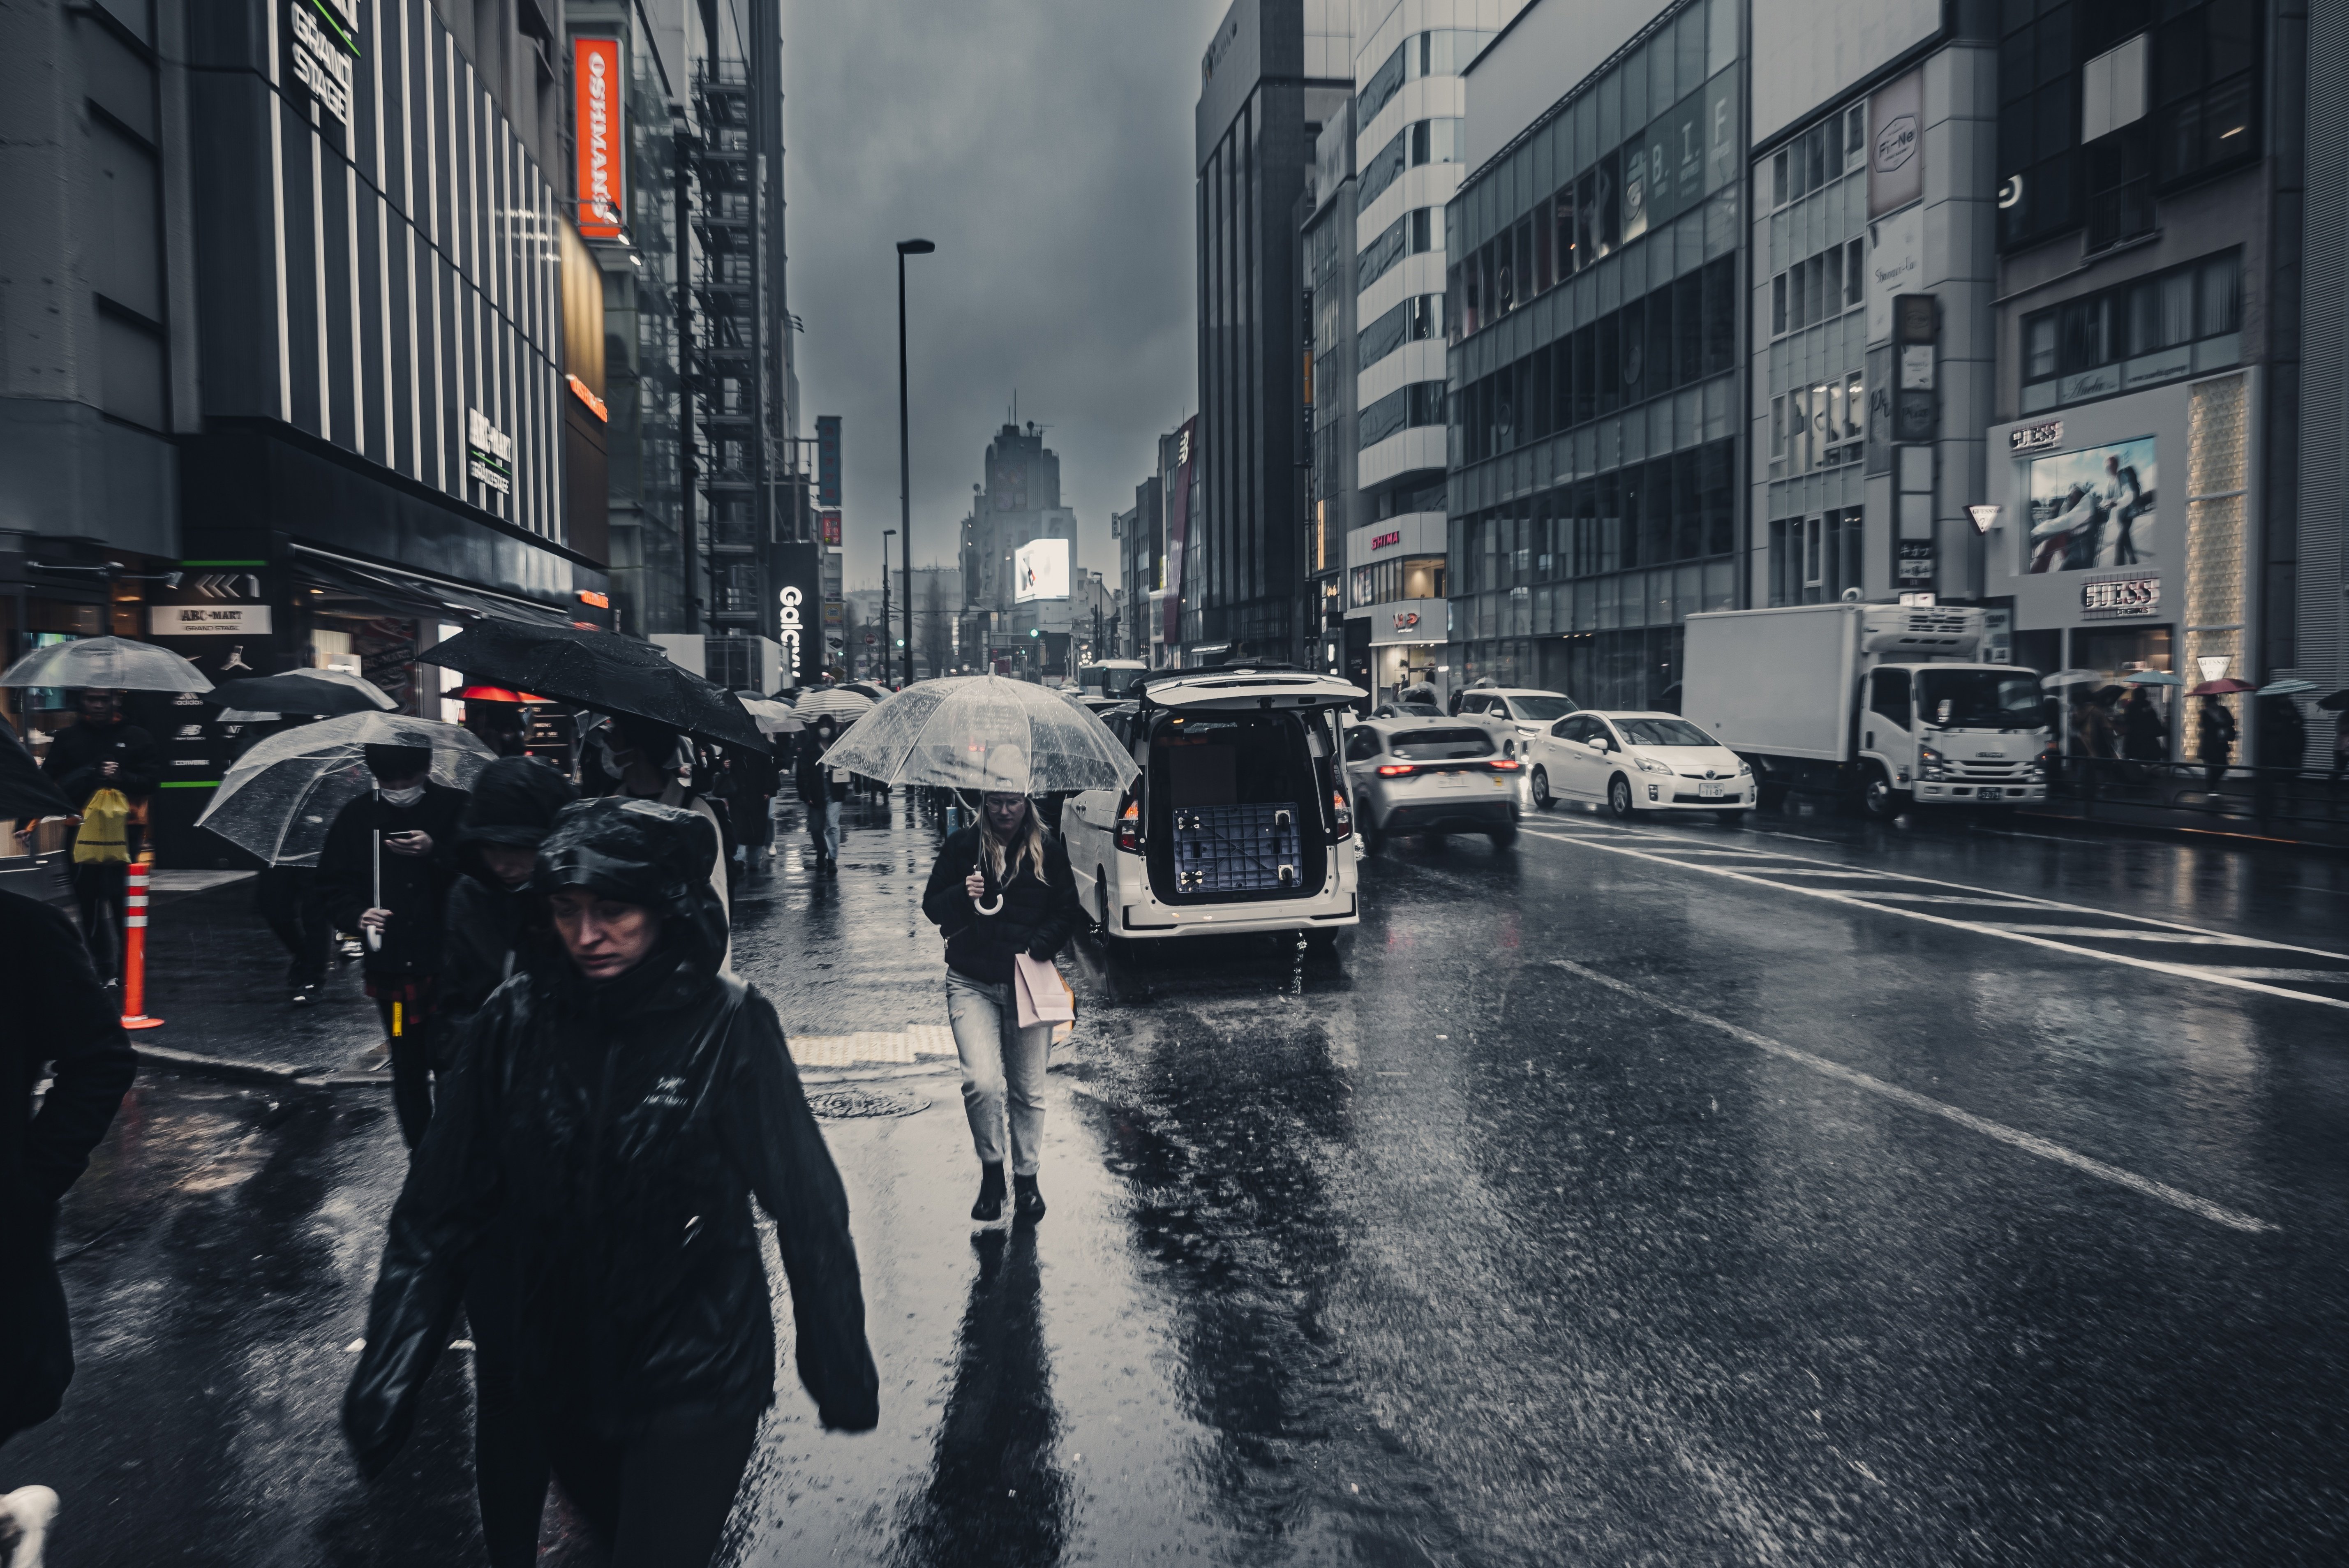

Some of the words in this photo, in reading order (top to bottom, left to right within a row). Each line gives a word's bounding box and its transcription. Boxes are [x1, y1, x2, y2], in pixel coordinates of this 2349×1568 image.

[291, 1, 352, 93] GRAND
[292, 42, 347, 126] STAGE
[469, 407, 511, 463] ABC-MART
[1371, 530, 1398, 550] SHIMA
[2081, 579, 2160, 609] GUESS
[181, 610, 243, 621] ABC-MART
[362, 649, 411, 669] BC-MART
